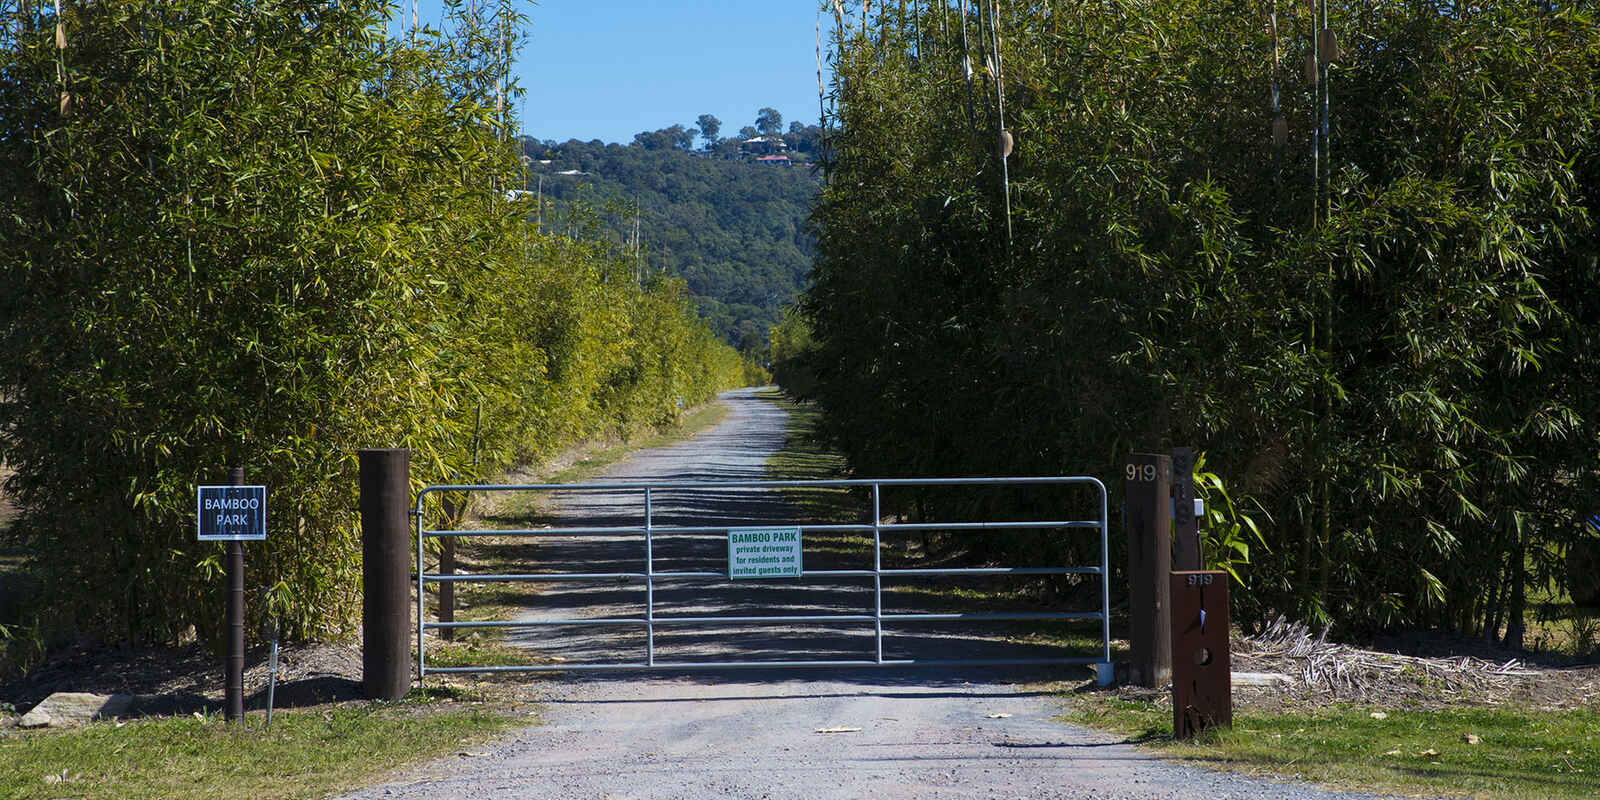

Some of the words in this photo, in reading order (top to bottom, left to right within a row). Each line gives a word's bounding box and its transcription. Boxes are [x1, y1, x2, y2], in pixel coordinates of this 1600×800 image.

[1126, 463, 1156, 481] 919
[205, 498, 259, 510] BAMBOO
[216, 514, 248, 525] PARK
[732, 533, 770, 543] BAMBOO
[773, 532, 797, 542] PARK
[736, 545, 761, 554] private
[762, 544, 793, 552] driveway
[736, 556, 746, 564] for
[781, 555, 795, 563] and
[733, 567, 757, 575] invited
[758, 566, 781, 575] guests
[783, 565, 798, 574] only
[1188, 574, 1213, 585] 919
